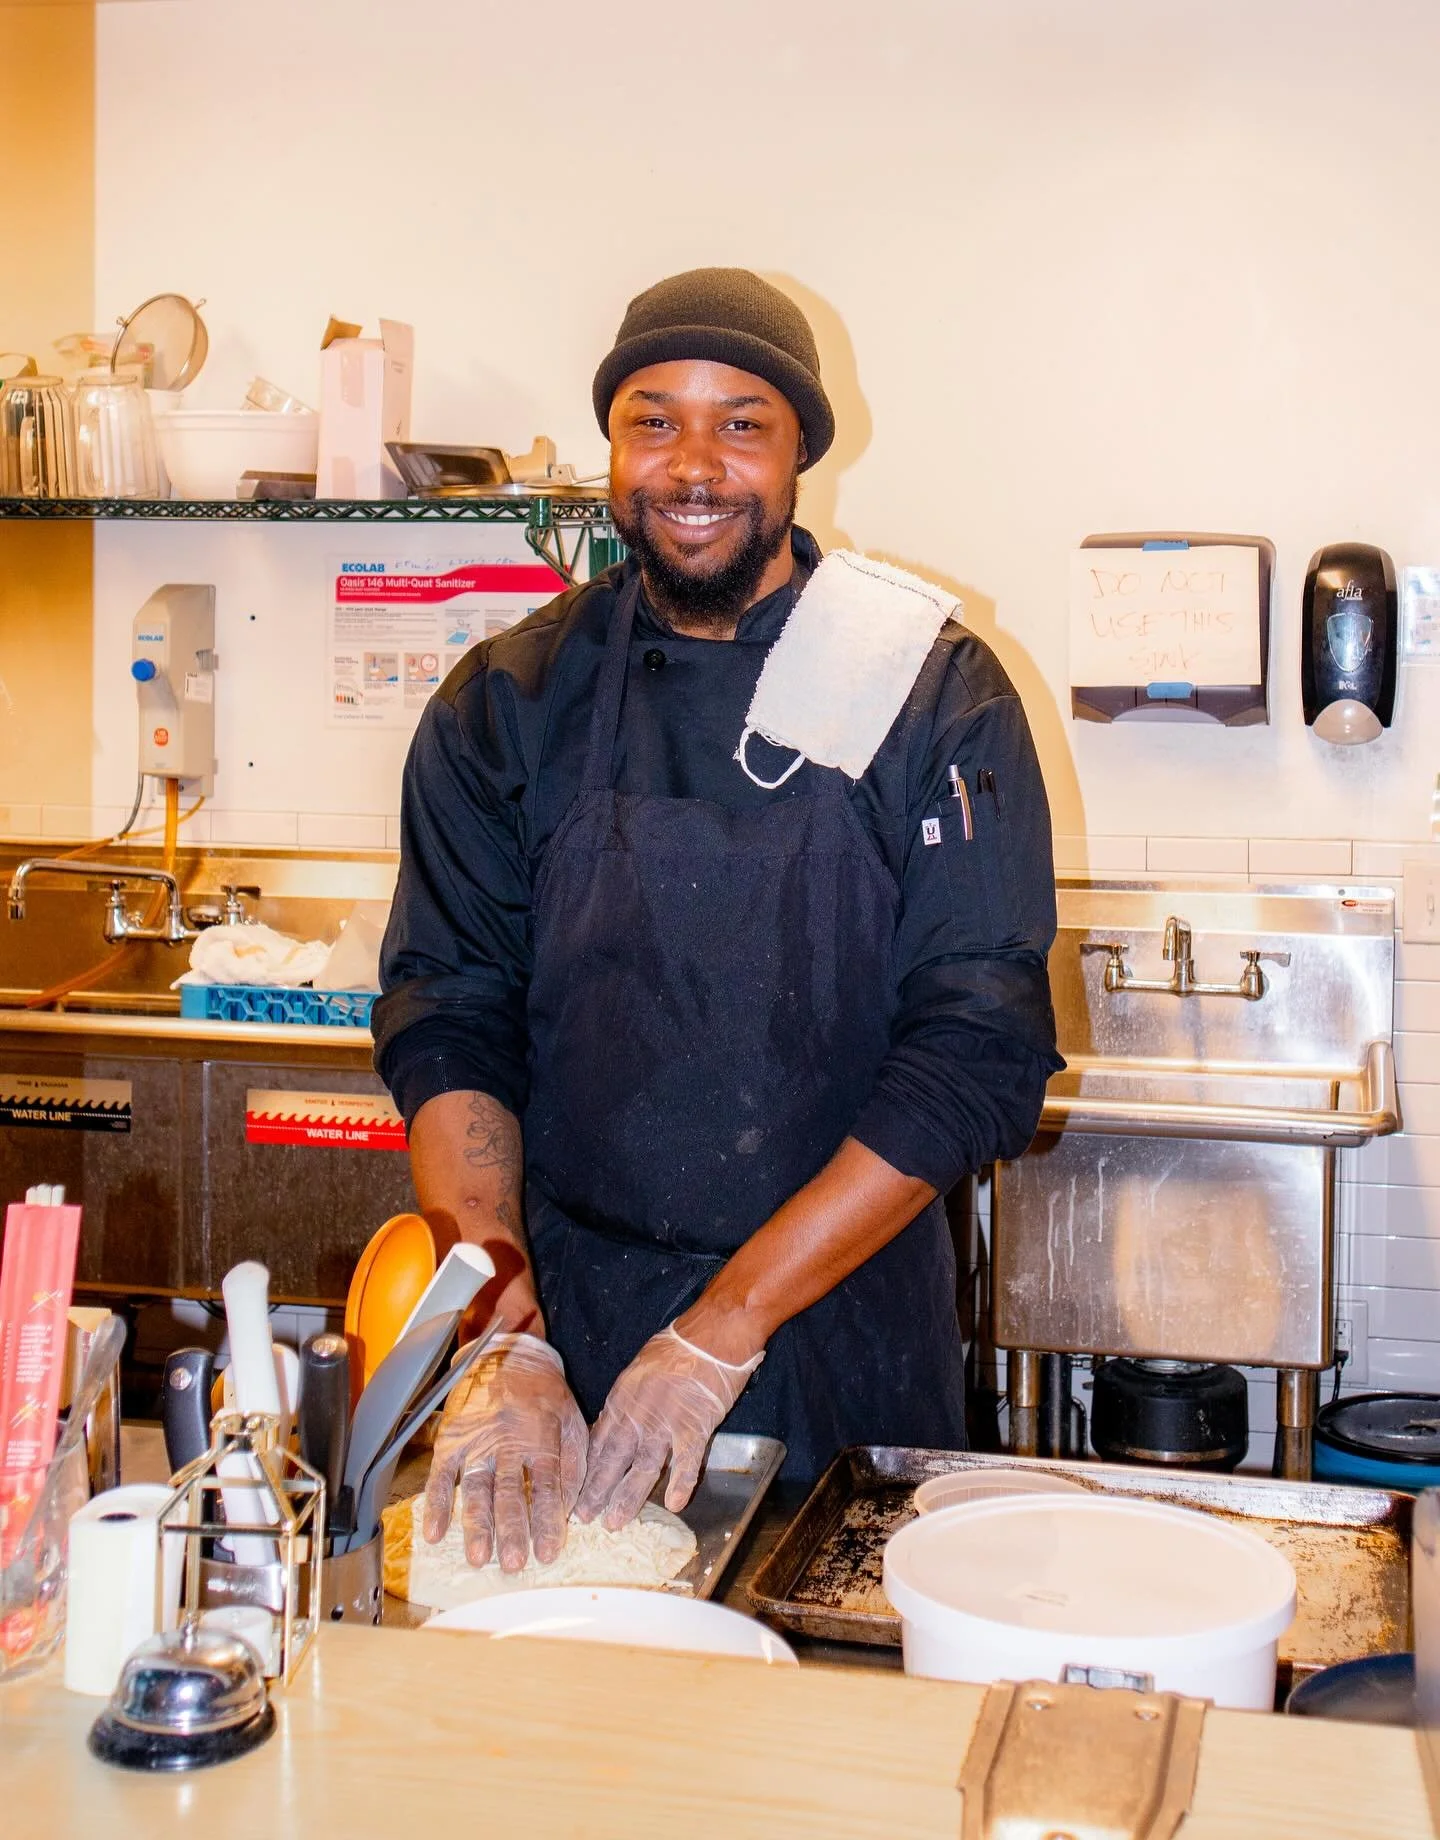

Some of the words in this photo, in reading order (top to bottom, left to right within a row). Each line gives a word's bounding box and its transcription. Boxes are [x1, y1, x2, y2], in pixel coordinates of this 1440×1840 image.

[341, 563, 385, 573] ECOLAB
[340, 577, 364, 587] Oasis
[367, 578, 384, 588] 146
[385, 578, 433, 588] Multi-Quat
[435, 579, 477, 589] Sanitizer
[1090, 569, 1140, 598] DO
[1160, 570, 1227, 594] NOT
[1090, 611, 1160, 639] USE
[1169, 610, 1236, 634] THIS
[11, 1109, 47, 1121] WATER
[49, 1111, 72, 1122] LINE
[306, 1128, 343, 1140] WATER
[346, 1131, 369, 1142] LINE
